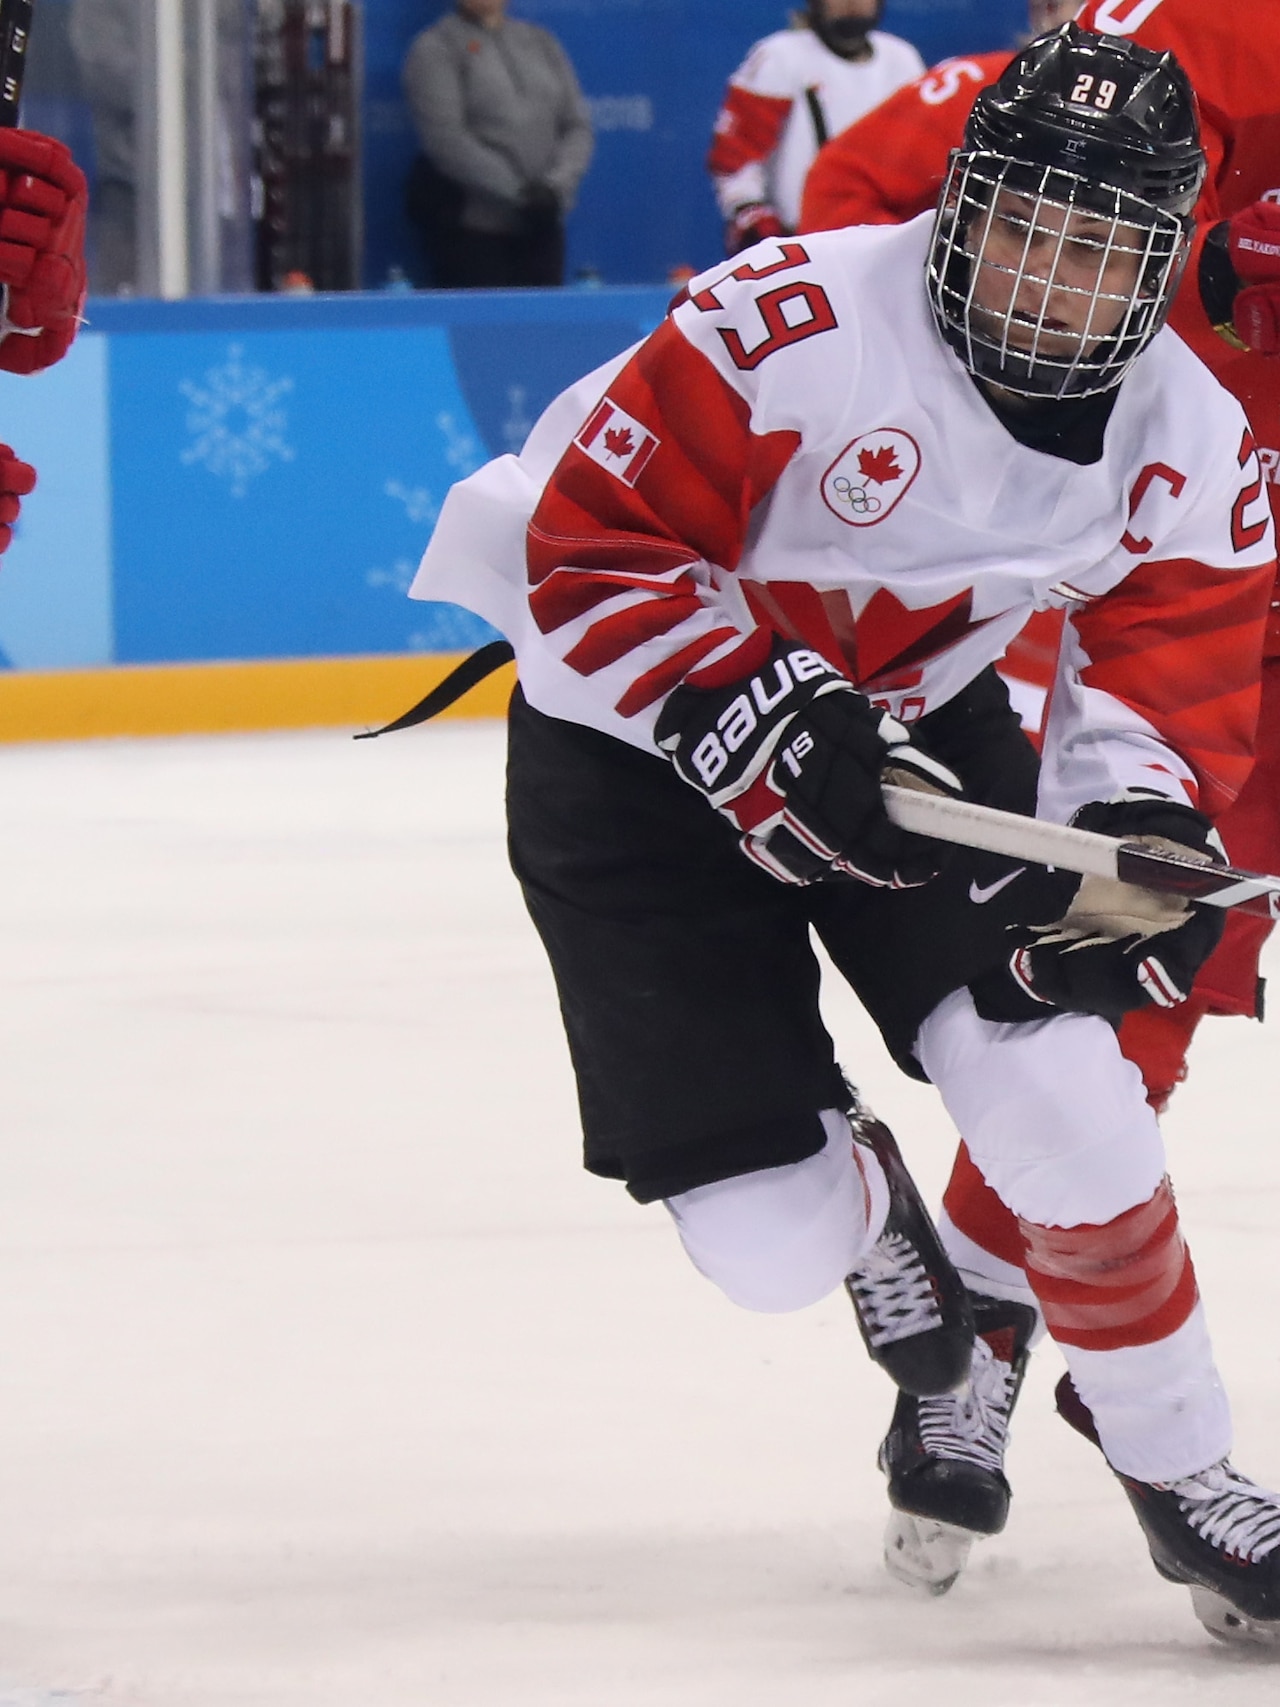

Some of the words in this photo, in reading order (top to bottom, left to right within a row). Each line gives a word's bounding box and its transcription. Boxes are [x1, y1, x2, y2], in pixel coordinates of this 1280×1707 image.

[1070, 73, 1118, 111] 29
[680, 243, 839, 381] 29
[1120, 461, 1187, 554] C
